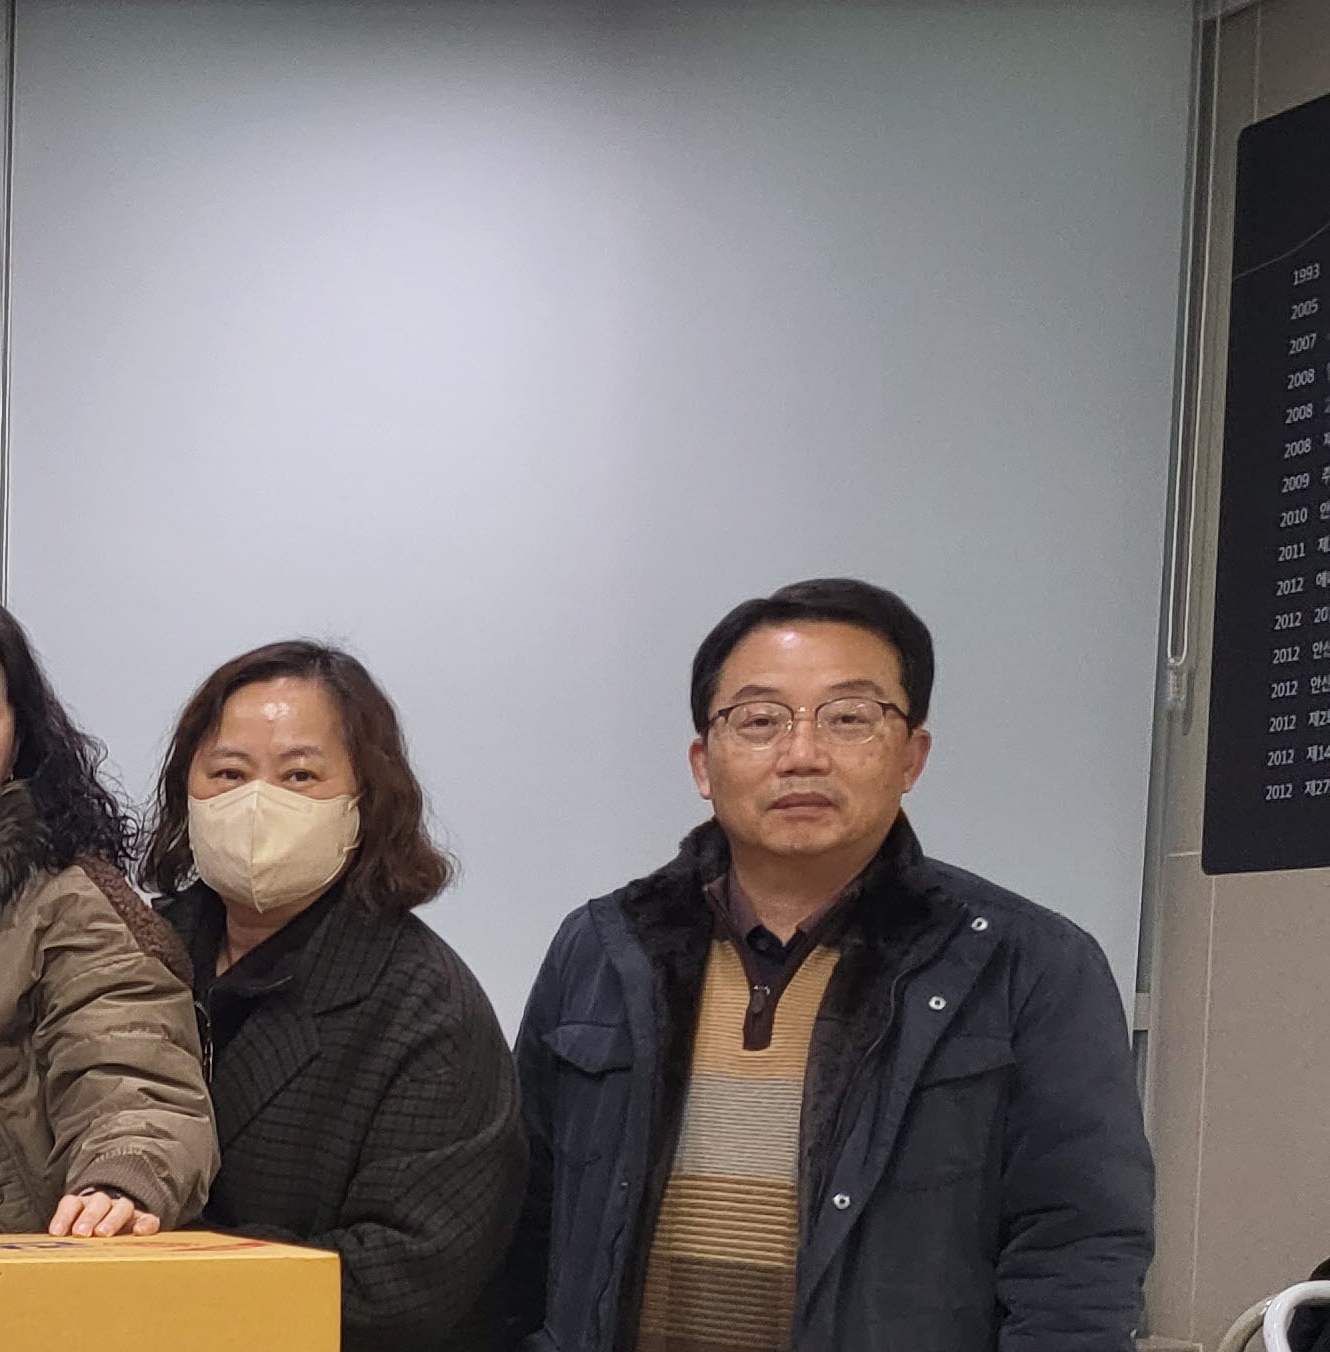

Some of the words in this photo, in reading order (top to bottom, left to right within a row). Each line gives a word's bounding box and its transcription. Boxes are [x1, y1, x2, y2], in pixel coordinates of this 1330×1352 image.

[1293, 263, 1320, 286] 1993
[1291, 298, 1318, 320] 2005
[1289, 333, 1316, 355] 2007
[1288, 368, 1315, 389] 2008
[1286, 403, 1313, 424] 2008
[1284, 439, 1311, 459] 2008
[1282, 473, 1309, 493] 2009
[1280, 508, 1307, 527] 2010
[1278, 542, 1305, 562] 2011
[1276, 577, 1303, 596] 2012
[1274, 612, 1302, 630] 2012
[1273, 646, 1300, 664] 2012
[1271, 681, 1298, 699] 2012
[1269, 715, 1296, 732] 2012
[1267, 749, 1294, 766] 2012
[1265, 783, 1292, 801] 2012
